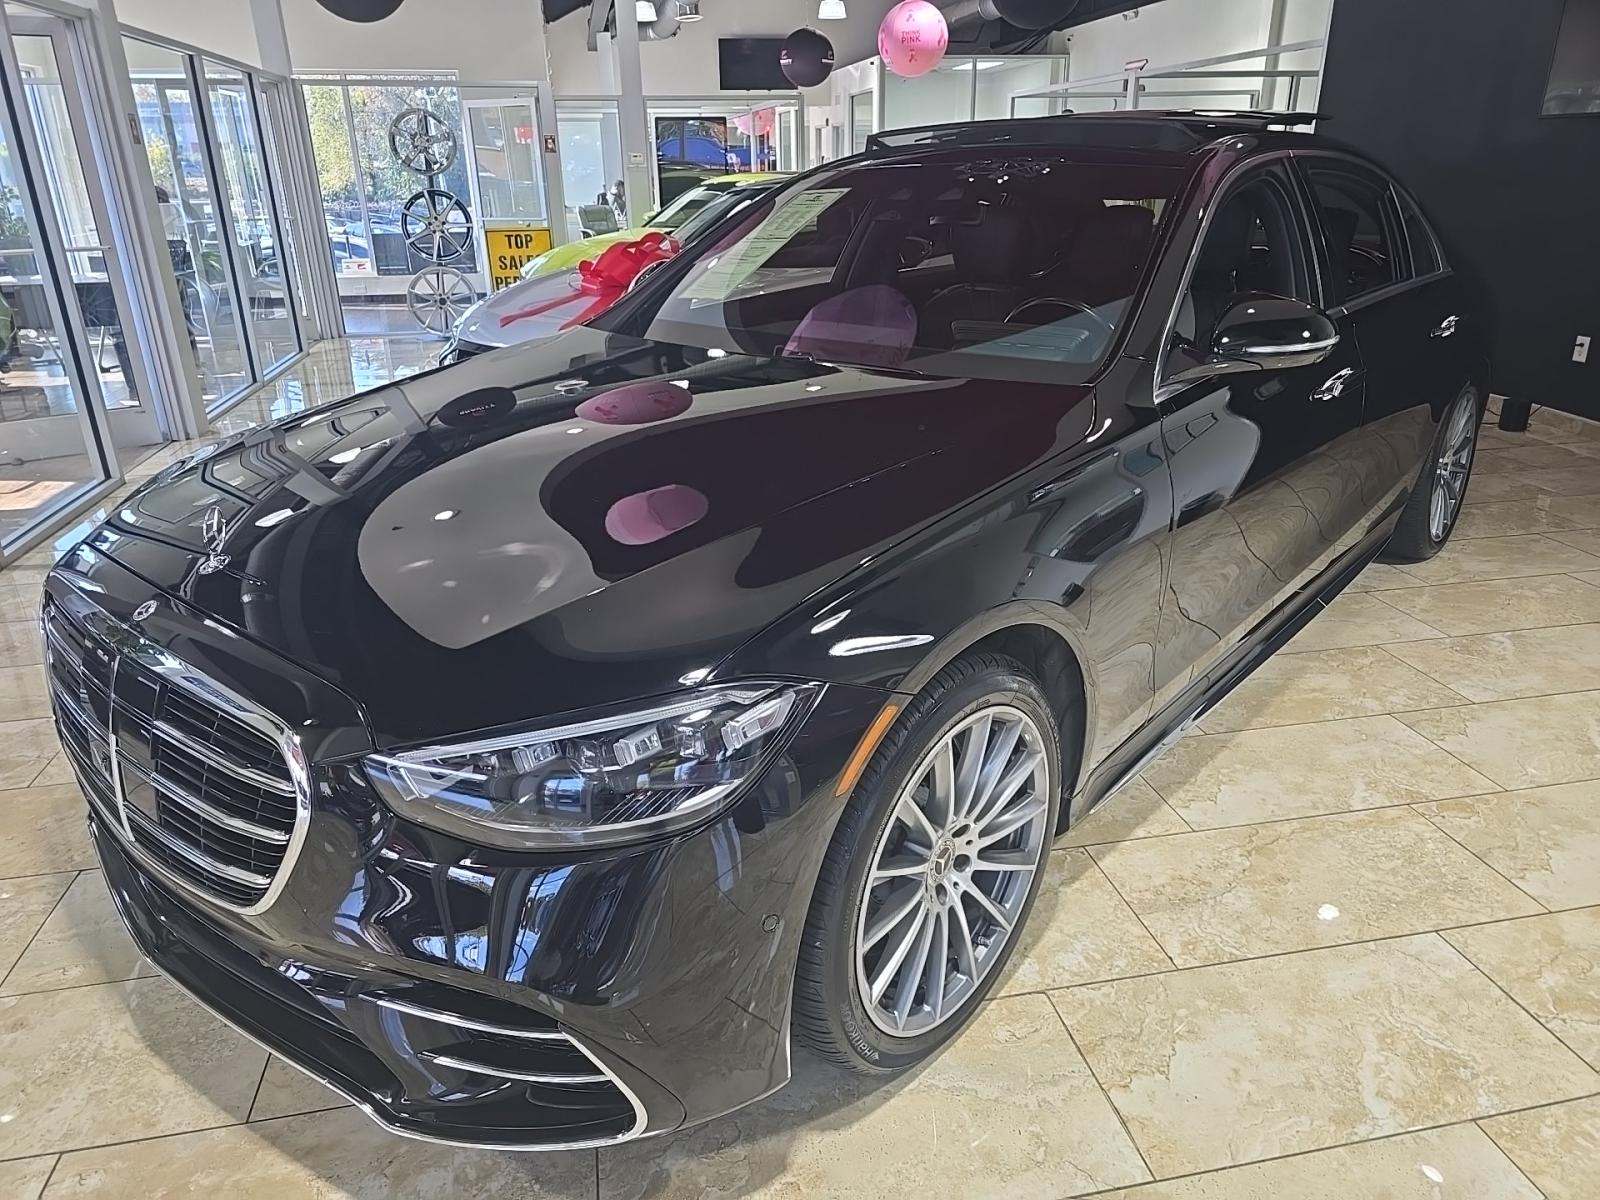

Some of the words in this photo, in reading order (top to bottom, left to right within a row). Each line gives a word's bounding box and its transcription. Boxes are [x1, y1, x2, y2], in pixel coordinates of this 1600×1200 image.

[901, 36, 921, 44] PINK
[504, 233, 533, 249] TOP
[498, 254, 542, 271] SAL
